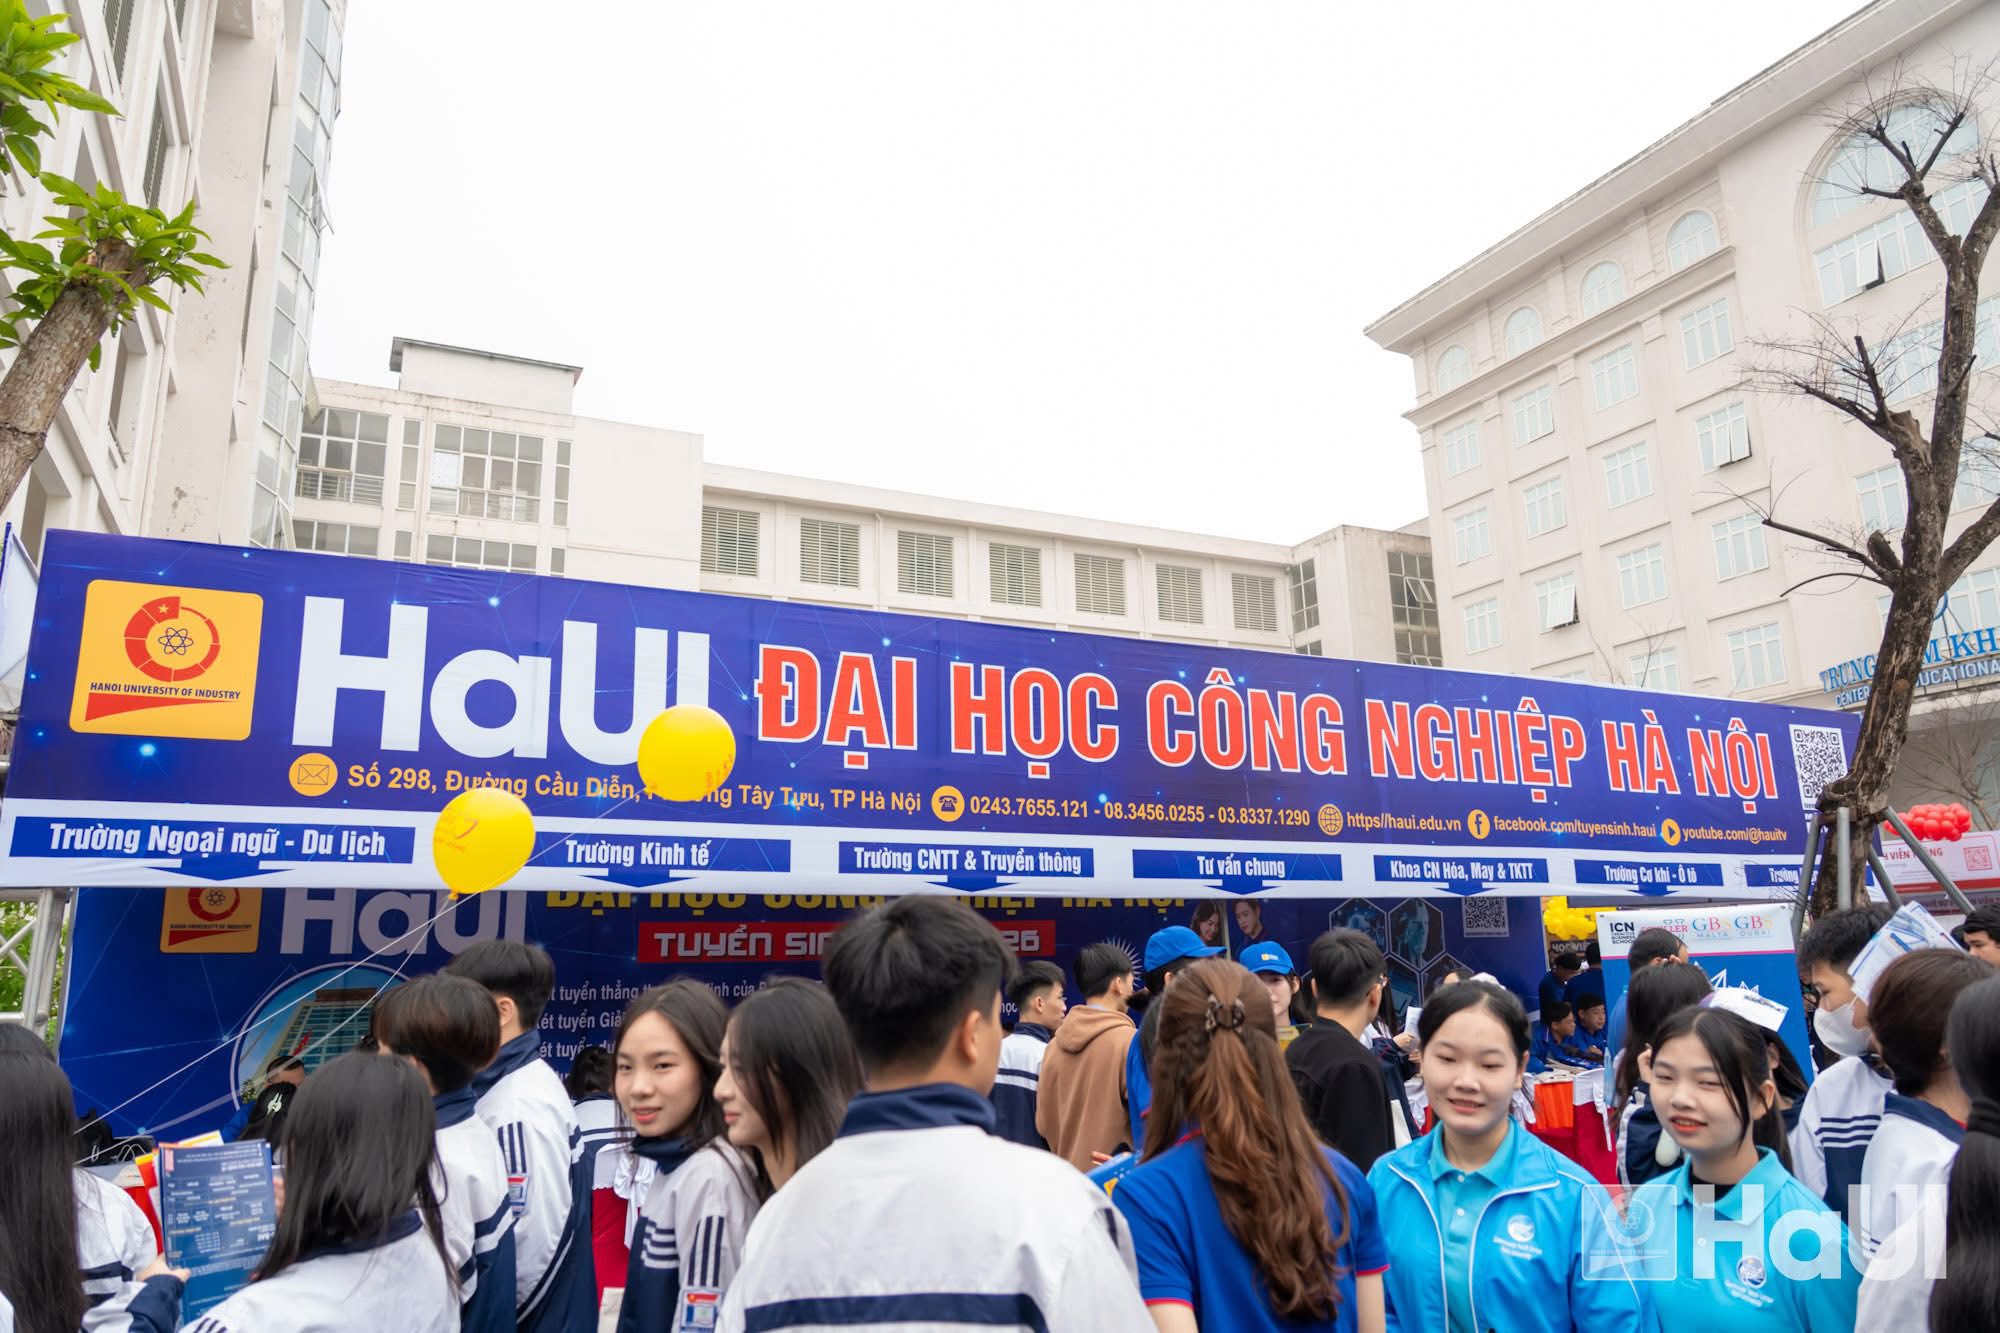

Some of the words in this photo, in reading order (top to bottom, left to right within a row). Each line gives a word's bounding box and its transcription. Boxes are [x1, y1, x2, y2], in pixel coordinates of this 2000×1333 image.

[292, 595, 710, 766] HaUI
[1818, 654, 1877, 693] TRUNG
[90, 682, 121, 692] HANOI
[123, 684, 179, 696] UNIVERSITY
[181, 688, 193, 697] OF
[195, 689, 240, 700] INDUSTRY
[1836, 685, 1870, 706] CENTER
[754, 643, 918, 770] ĐẠI
[950, 661, 1120, 779] HỌC
[1146, 667, 1348, 776] CÔNG
[1364, 696, 1587, 803] NGHIỆP
[1601, 708, 1681, 796] HÀ
[1687, 717, 1779, 814] NỘI
[348, 761, 381, 789] Số
[388, 768, 437, 794] 298,
[445, 770, 528, 799] Đường
[535, 771, 579, 797] Cầu
[586, 774, 640, 804] Diễn,
[738, 784, 775, 809] Tây
[780, 787, 825, 815] Tựu,
[830, 789, 856, 808] TP
[861, 790, 885, 810] Hà
[891, 792, 921, 815] Nội
[970, 796, 1088, 818] 0243.7655.121
[1104, 802, 1204, 823] 08.3456.0255
[1218, 807, 1310, 826] 03.8337.1290
[1347, 812, 1461, 832] https//haui.edu.vn
[50, 823, 140, 853] Trường
[148, 825, 225, 858] Ngoại
[231, 827, 280, 856] ngữ
[302, 829, 334, 855] Du
[340, 830, 385, 860] lịch
[565, 839, 634, 866] Trường
[640, 841, 685, 866] Kinh
[691, 840, 713, 866] tế
[854, 846, 913, 872] Trường
[917, 848, 959, 871] CNTT
[964, 850, 977, 871] &
[981, 848, 1035, 874] Truyền
[1038, 852, 1081, 875] thông
[1197, 855, 1214, 876] Tư
[1216, 853, 1241, 877] vấn
[1245, 857, 1285, 879] chung
[1390, 860, 1420, 879] Khoa
[1423, 862, 1440, 879] CN
[1443, 861, 1469, 881] Hóa,
[1470, 862, 1494, 882] May
[1497, 863, 1506, 879] &
[1508, 862, 1533, 879] TKTT
[1604, 865, 1638, 884] Trường
[1610, 922, 1635, 932] ICN
[654, 924, 773, 957] TUYỂN
[560, 980, 597, 1005] tuyển
[558, 1008, 595, 1032] tuyển
